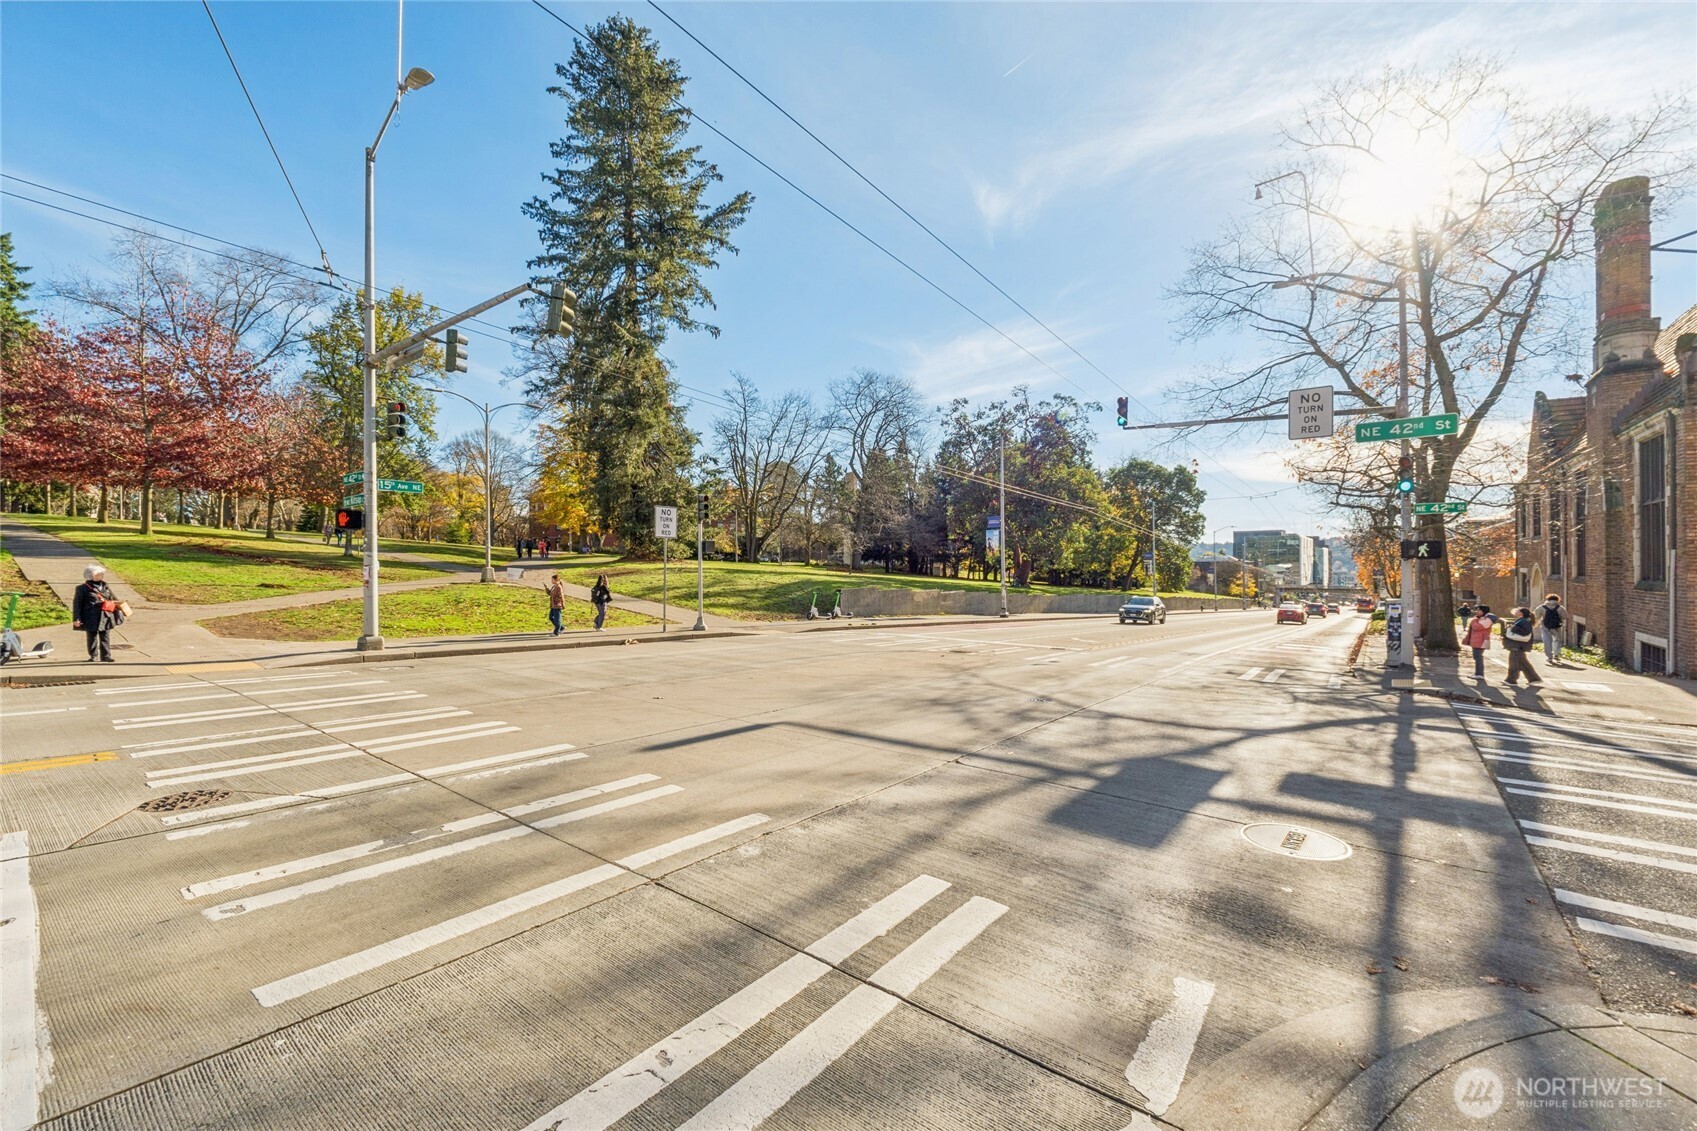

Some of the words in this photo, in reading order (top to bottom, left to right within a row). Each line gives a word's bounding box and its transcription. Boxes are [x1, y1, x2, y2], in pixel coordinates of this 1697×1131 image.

[1300, 392, 1321, 404] NO
[1297, 404, 1324, 414] TURN
[1303, 415, 1317, 424] ON
[1301, 424, 1320, 434] RED
[1361, 427, 1381, 438] NE
[1389, 421, 1424, 435] 42nd
[1435, 419, 1451, 430] St
[1430, 504, 1455, 512] 42nd
